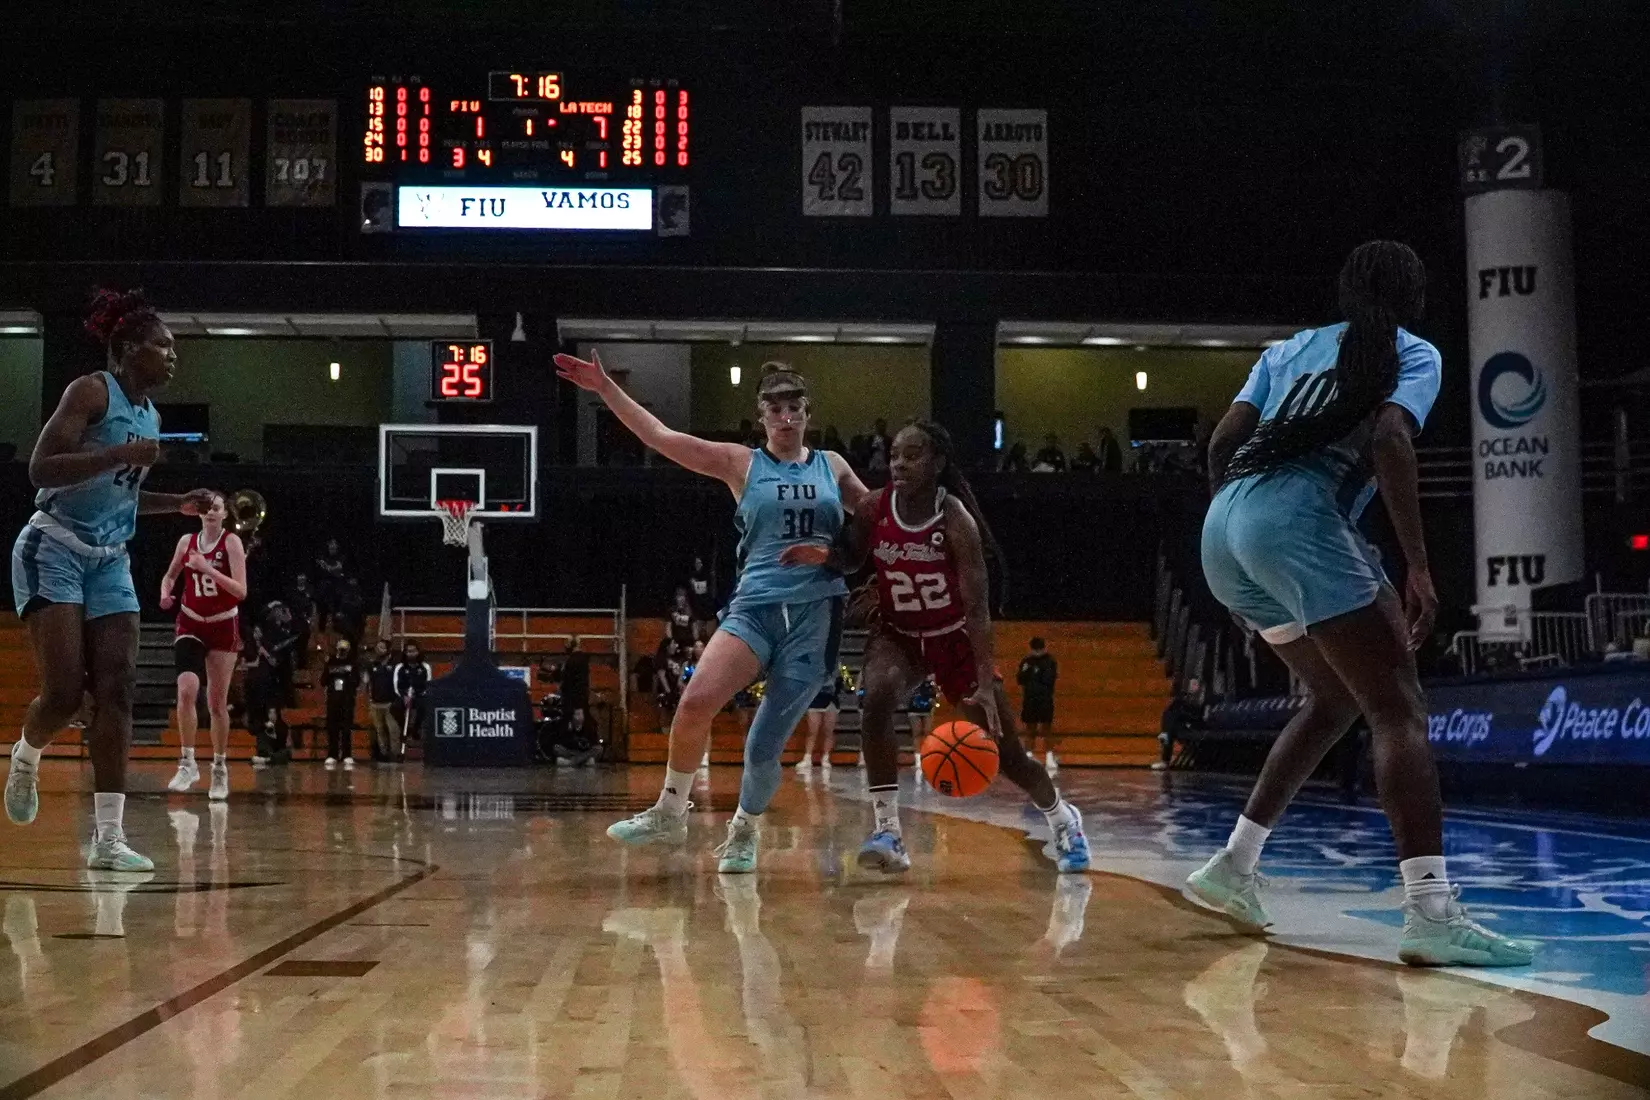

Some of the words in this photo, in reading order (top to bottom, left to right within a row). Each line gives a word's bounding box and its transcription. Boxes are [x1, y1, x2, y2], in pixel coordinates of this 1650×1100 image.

[369, 86, 384, 101] 10
[397, 86, 408, 101] 0
[419, 86, 430, 101] 0
[509, 74, 561, 100] 7:16
[633, 89, 643, 104] 3
[654, 89, 667, 104] 0
[678, 89, 689, 104] 3
[369, 101, 384, 116] 13
[397, 101, 408, 116] 0
[424, 101, 430, 116] 1
[449, 99, 482, 113] FIU
[559, 101, 578, 114] LA
[580, 101, 614, 115] TECH
[627, 104, 643, 119] 18
[654, 104, 667, 119] 0
[678, 104, 689, 119] 0
[369, 117, 384, 131] 15
[397, 117, 408, 131] 0
[419, 117, 430, 131] 0
[475, 115, 485, 138] 1
[525, 117, 534, 137] 1
[592, 115, 608, 140] 7
[622, 119, 643, 134] 22
[654, 119, 667, 134] 0
[678, 119, 689, 134] 0
[805, 122, 870, 142] STEWART
[896, 122, 956, 142] BELL
[364, 131, 384, 146] 24
[397, 131, 408, 146] 0
[419, 131, 430, 146] 0
[622, 135, 643, 149] 23
[654, 135, 667, 149] 0
[678, 135, 689, 149] 2
[365, 147, 384, 162] 30
[401, 147, 407, 162] 1
[419, 147, 430, 162] 0
[452, 146, 467, 168] 3
[477, 149, 492, 168] 4
[560, 149, 576, 168] 4
[599, 149, 608, 168] 1
[622, 150, 643, 165] 25
[654, 150, 667, 165] 0
[678, 150, 689, 165] 0
[1495, 136, 1531, 180] 2
[29, 152, 55, 186] 4
[102, 152, 151, 187] 31
[192, 152, 235, 188] 11
[275, 158, 328, 182] 707
[808, 151, 864, 202] 42
[895, 151, 957, 201] 13
[984, 152, 1043, 202] 30
[461, 197, 506, 217] FIU
[541, 192, 630, 210] VAMOS
[1479, 265, 1538, 299] FIU
[448, 345, 486, 364] 7:16
[441, 363, 482, 396] 25
[1480, 435, 1549, 458] OCEAN
[1484, 457, 1543, 480] BANK
[777, 484, 817, 501] FIU
[781, 509, 816, 540] 30
[1487, 554, 1546, 585] FIU
[192, 573, 219, 598] 18
[884, 570, 952, 611] 22
[469, 707, 517, 724] Baptist
[1561, 701, 1619, 741] Peace
[469, 724, 515, 738] Health
[1446, 708, 1493, 747] Corps
